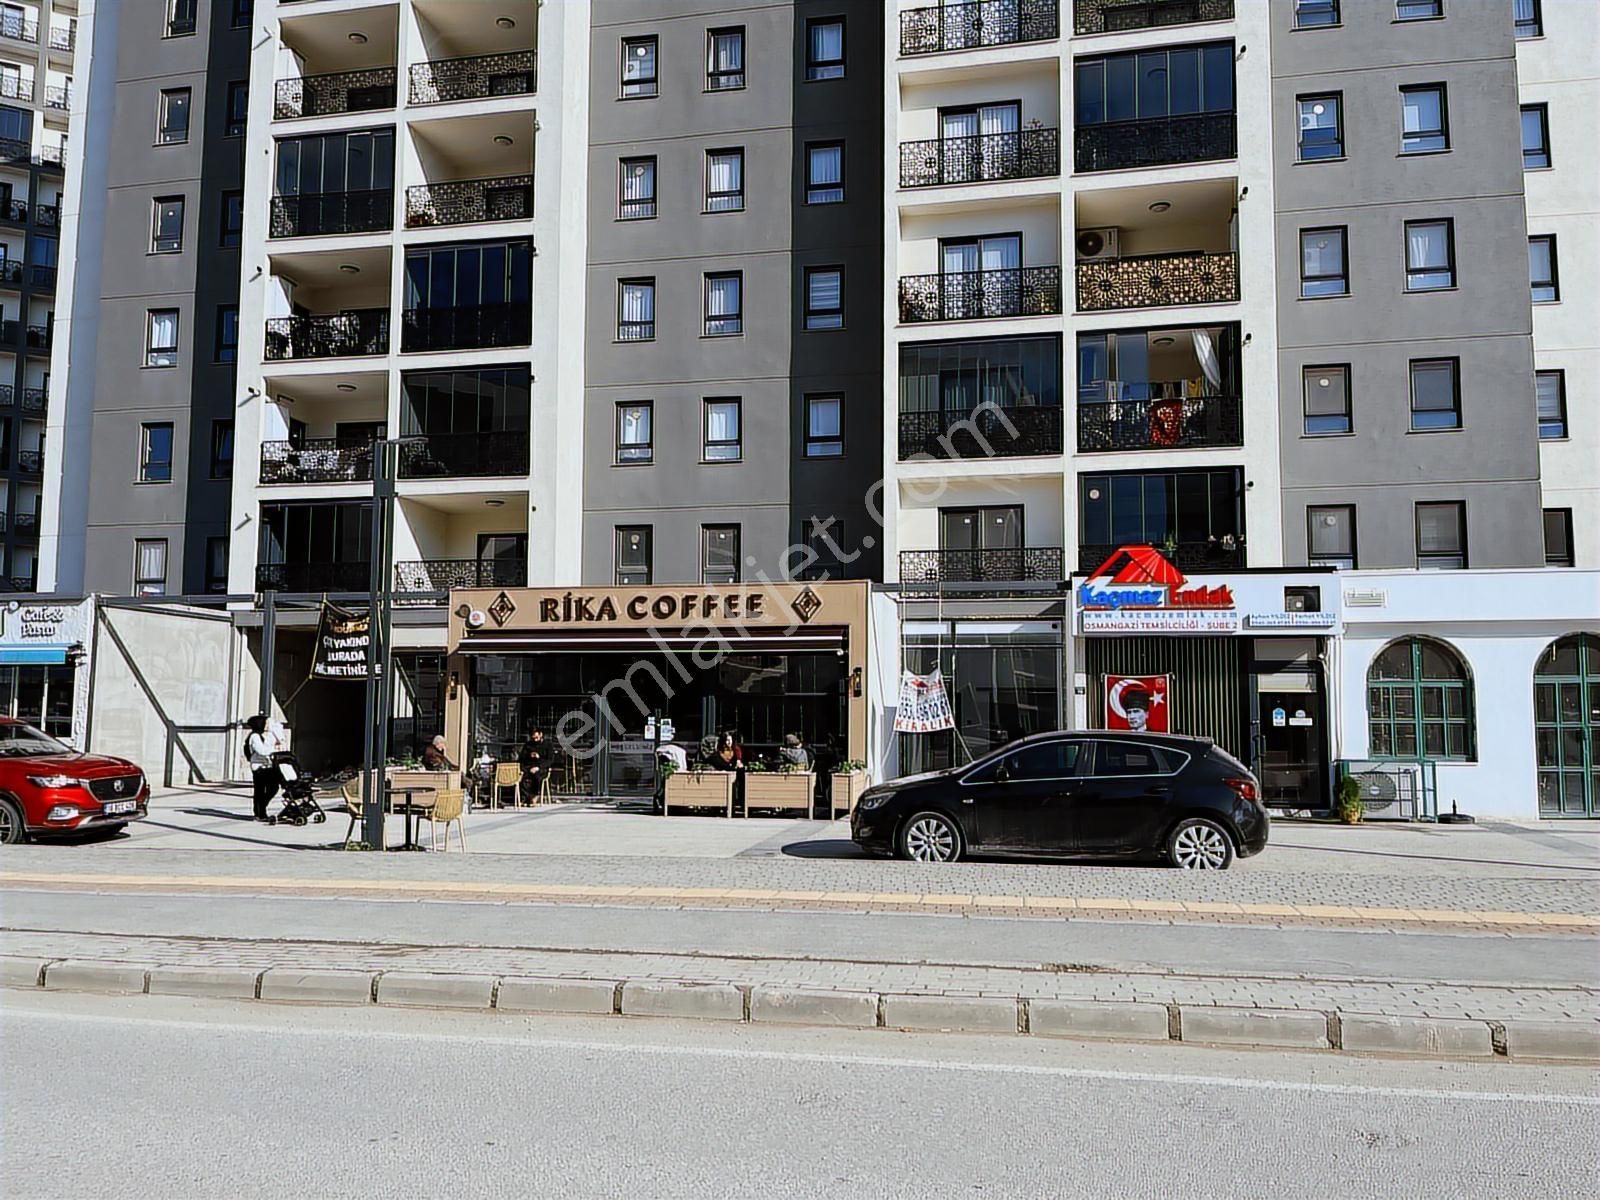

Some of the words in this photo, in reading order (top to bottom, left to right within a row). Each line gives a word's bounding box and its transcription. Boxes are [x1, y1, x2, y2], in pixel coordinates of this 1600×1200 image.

[540, 591, 617, 622] RİKA
[627, 594, 764, 620] COFFEE
[1084, 620, 1139, 629] OSMANGAZİ
[334, 635, 370, 648] YAKIND
